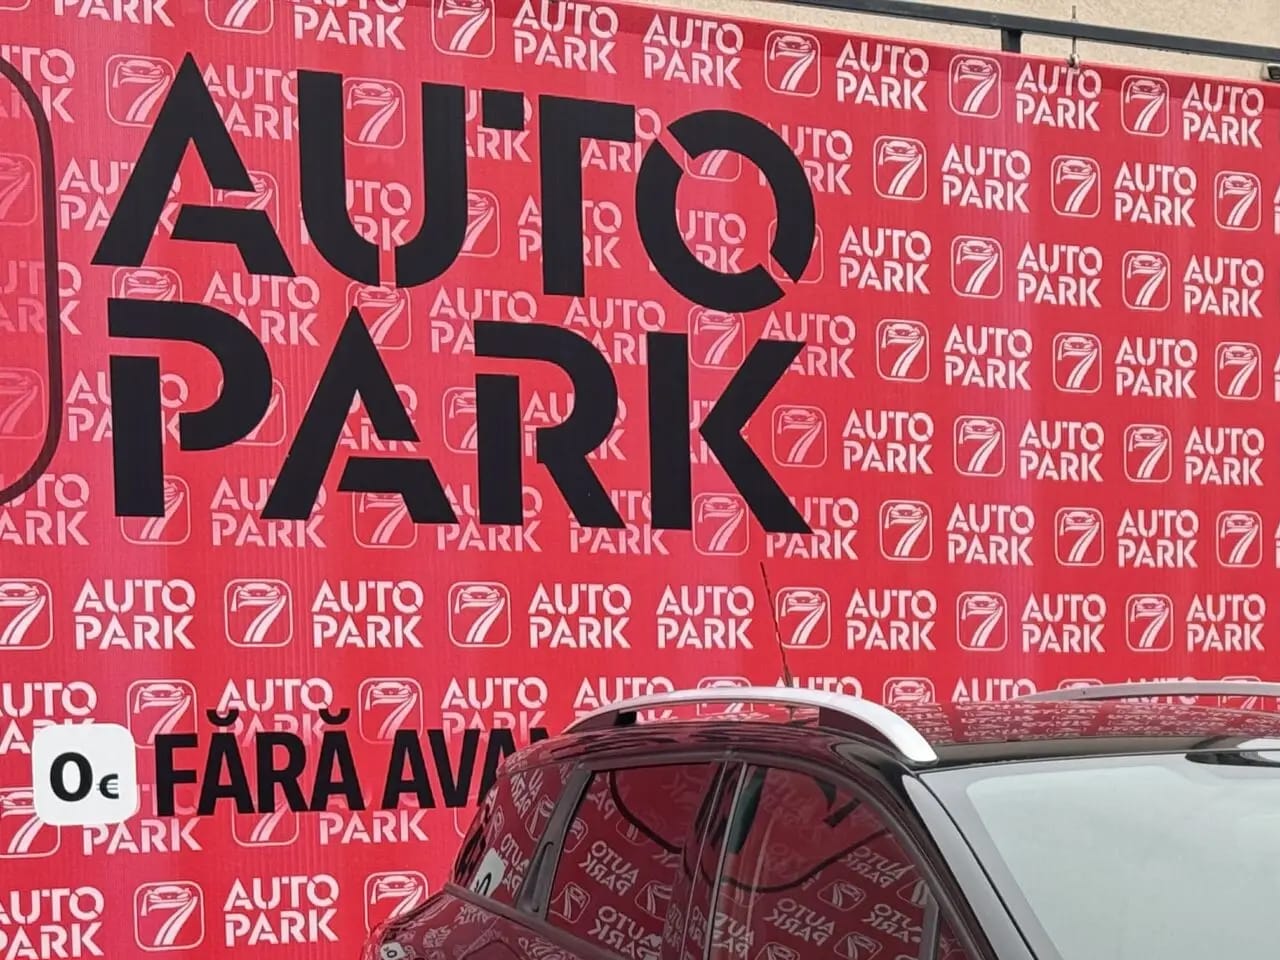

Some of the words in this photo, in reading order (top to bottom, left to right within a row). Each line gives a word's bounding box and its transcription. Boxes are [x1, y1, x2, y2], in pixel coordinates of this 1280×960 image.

[294, 6, 406, 51] PARK
[512, 0, 618, 39] AUTO
[643, 15, 744, 55] AUTO
[514, 29, 617, 75] PARK
[644, 45, 742, 90] PARK
[836, 41, 930, 79] AUTO
[836, 69, 928, 112] PARK
[1015, 64, 1102, 99] AUTO
[1015, 92, 1101, 132] PARK
[1181, 83, 1264, 118] AUTO
[1183, 110, 1263, 149] PARK
[941, 143, 1031, 182] AUTO
[1113, 161, 1197, 197] AUTO
[91, 52, 816, 312] AUTO
[942, 174, 1030, 214] PARK
[1114, 191, 1196, 228] PARK
[838, 225, 932, 262] AUTO
[1016, 241, 1103, 277] AUTO
[839, 256, 930, 295] PARK
[1017, 271, 1102, 308] PARK
[1182, 254, 1265, 289] AUTO
[203, 270, 320, 311] AUTO
[430, 285, 538, 323] AUTO
[1183, 284, 1263, 318] PARK
[564, 295, 667, 332] AUTO
[761, 310, 857, 347] AUTO
[943, 323, 1033, 359] AUTO
[1114, 336, 1198, 369] AUTO
[944, 354, 1032, 391] PARK
[1115, 365, 1197, 399] PARK
[107, 297, 814, 534] PARK
[842, 408, 934, 443] AUTO
[1018, 419, 1105, 452] AUTO
[1183, 426, 1265, 457] AUTO
[843, 439, 933, 475] PARK
[1019, 449, 1104, 483] PARK
[1185, 455, 1264, 487] PARK
[946, 502, 1035, 536] AUTO
[1116, 508, 1199, 539] AUTO
[947, 532, 1034, 566] PARK
[1117, 538, 1198, 569] PARK
[72, 578, 196, 614] AUTO
[311, 579, 424, 615] AUTO
[527, 582, 632, 616] AUTO
[655, 584, 755, 617] AUTO
[845, 588, 937, 621] AUTO
[1020, 593, 1107, 623] AUTO
[1185, 593, 1266, 623] AUTO
[74, 614, 196, 650] PARK
[312, 614, 424, 649] PARK
[529, 615, 631, 649] PARK
[657, 617, 754, 650] PARK
[846, 619, 937, 651] PARK
[1021, 621, 1105, 653] PARK
[1187, 622, 1265, 652] PARK
[0, 681, 97, 718] UTO
[216, 677, 334, 713] AUTO
[440, 676, 548, 710] AUTO
[154, 708, 366, 817] FĂRĂ
[83, 817, 203, 856] PARK
[319, 807, 429, 845] PARK
[222, 873, 340, 912] AUTO
[224, 908, 339, 947] PARK
